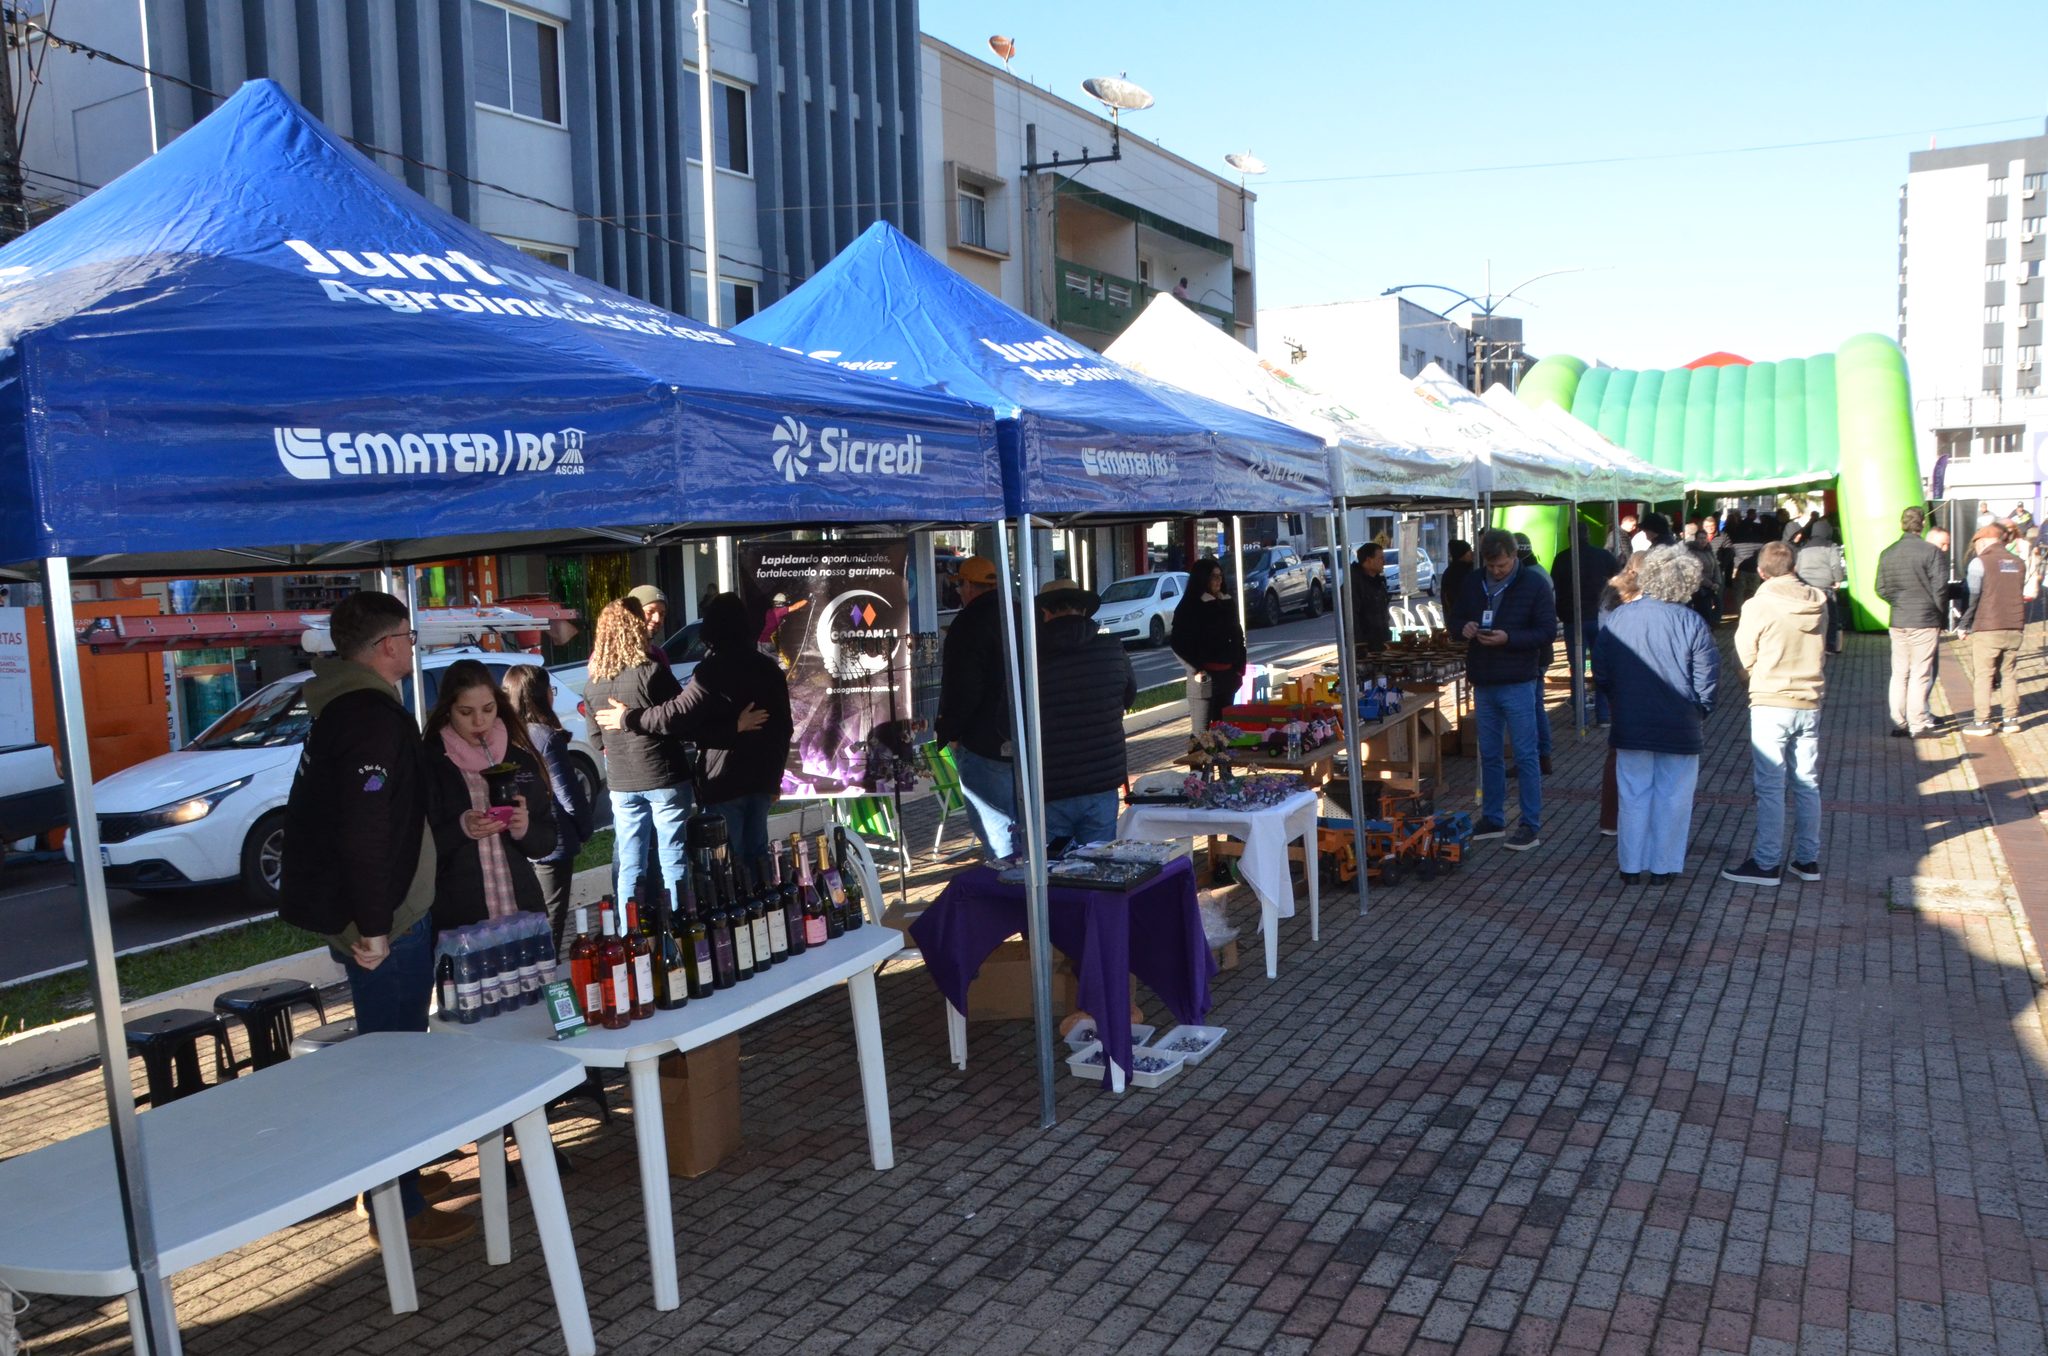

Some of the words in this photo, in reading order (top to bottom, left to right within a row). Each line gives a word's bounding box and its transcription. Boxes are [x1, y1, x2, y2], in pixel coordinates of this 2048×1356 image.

[283, 240, 594, 304] Juntos
[979, 335, 1084, 363] Junt
[327, 430, 556, 475] EMATER/RS
[818, 427, 922, 475] Sicredi
[1096, 449, 1169, 477] EMATER/RS
[555, 465, 585, 475] ASCAR
[756, 567, 817, 578] fortalecendo
[819, 567, 846, 577] nosso
[848, 566, 895, 578] garimpo.
[761, 554, 819, 567] Lapidando
[821, 553, 891, 566] oportunidades,
[0, 632, 22, 645] TAS
